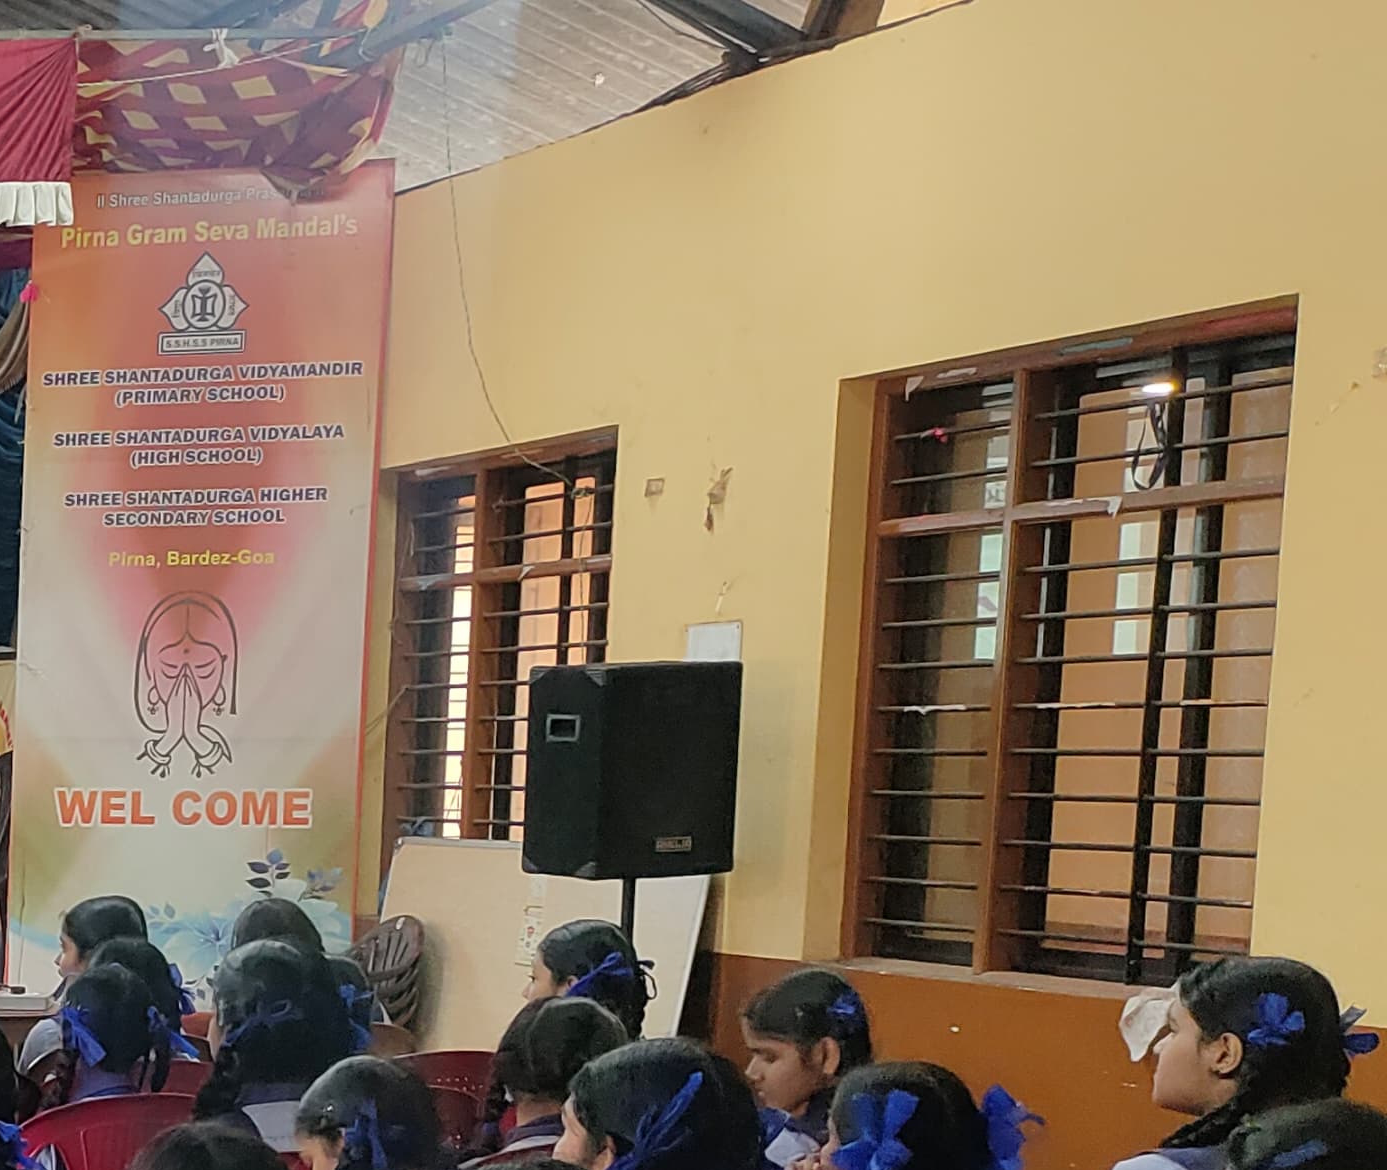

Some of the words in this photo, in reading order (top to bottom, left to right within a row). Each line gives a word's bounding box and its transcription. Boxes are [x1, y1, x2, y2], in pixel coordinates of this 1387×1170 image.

[109, 193, 148, 208] Shree
[153, 189, 241, 206] Shantadurga
[61, 227, 119, 249] Pirna
[127, 223, 187, 245] Gram
[194, 220, 248, 243] Seva
[256, 214, 358, 239] Mandal's
[43, 371, 100, 386] SHREE
[105, 366, 233, 385] SHANTADURGA
[239, 361, 363, 380] VIDYAMANDIR
[116, 388, 203, 407] (PRIMARY
[207, 385, 285, 402] SCHOOL)
[54, 432, 110, 447] SHREE
[115, 428, 244, 445] SHANTADURGA
[250, 424, 344, 442] VIDYALAYA
[131, 450, 180, 468] (HIGH
[185, 448, 263, 466] SCHOOL)
[65, 492, 121, 507] SHREE
[126, 489, 255, 506] SHANTADURGA
[259, 487, 328, 503] HIGHER
[103, 510, 208, 527] SECONDARY
[213, 508, 285, 524] SCHOOL
[109, 552, 161, 569] Pirna,
[166, 550, 274, 567] Bardez-Goa
[55, 789, 156, 827] WEL
[171, 788, 313, 827] COME
